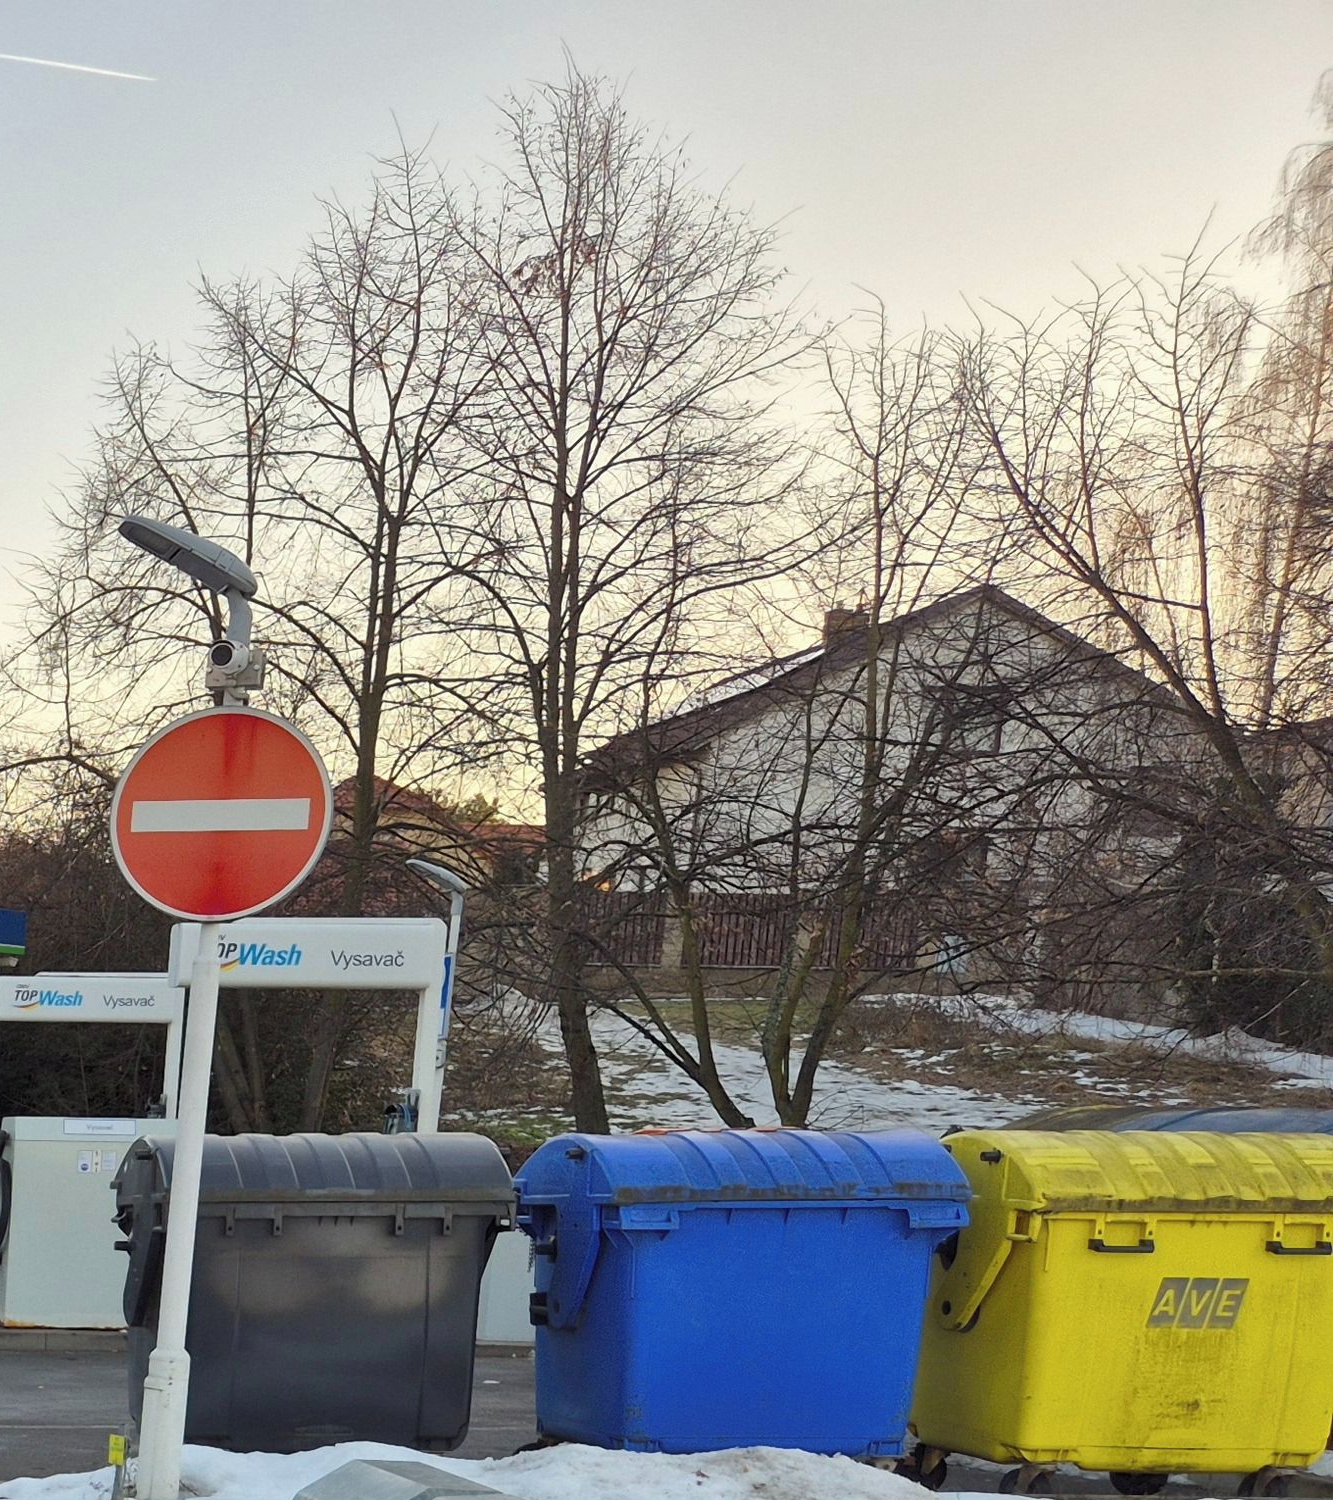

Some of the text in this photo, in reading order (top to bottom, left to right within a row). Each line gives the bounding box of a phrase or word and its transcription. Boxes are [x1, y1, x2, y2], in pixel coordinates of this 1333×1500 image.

[217, 942, 406, 970] OP Wash Vysavač
[15, 990, 155, 1009] TOP Wash Vysavač
[1152, 1289, 1242, 1317] AVE
